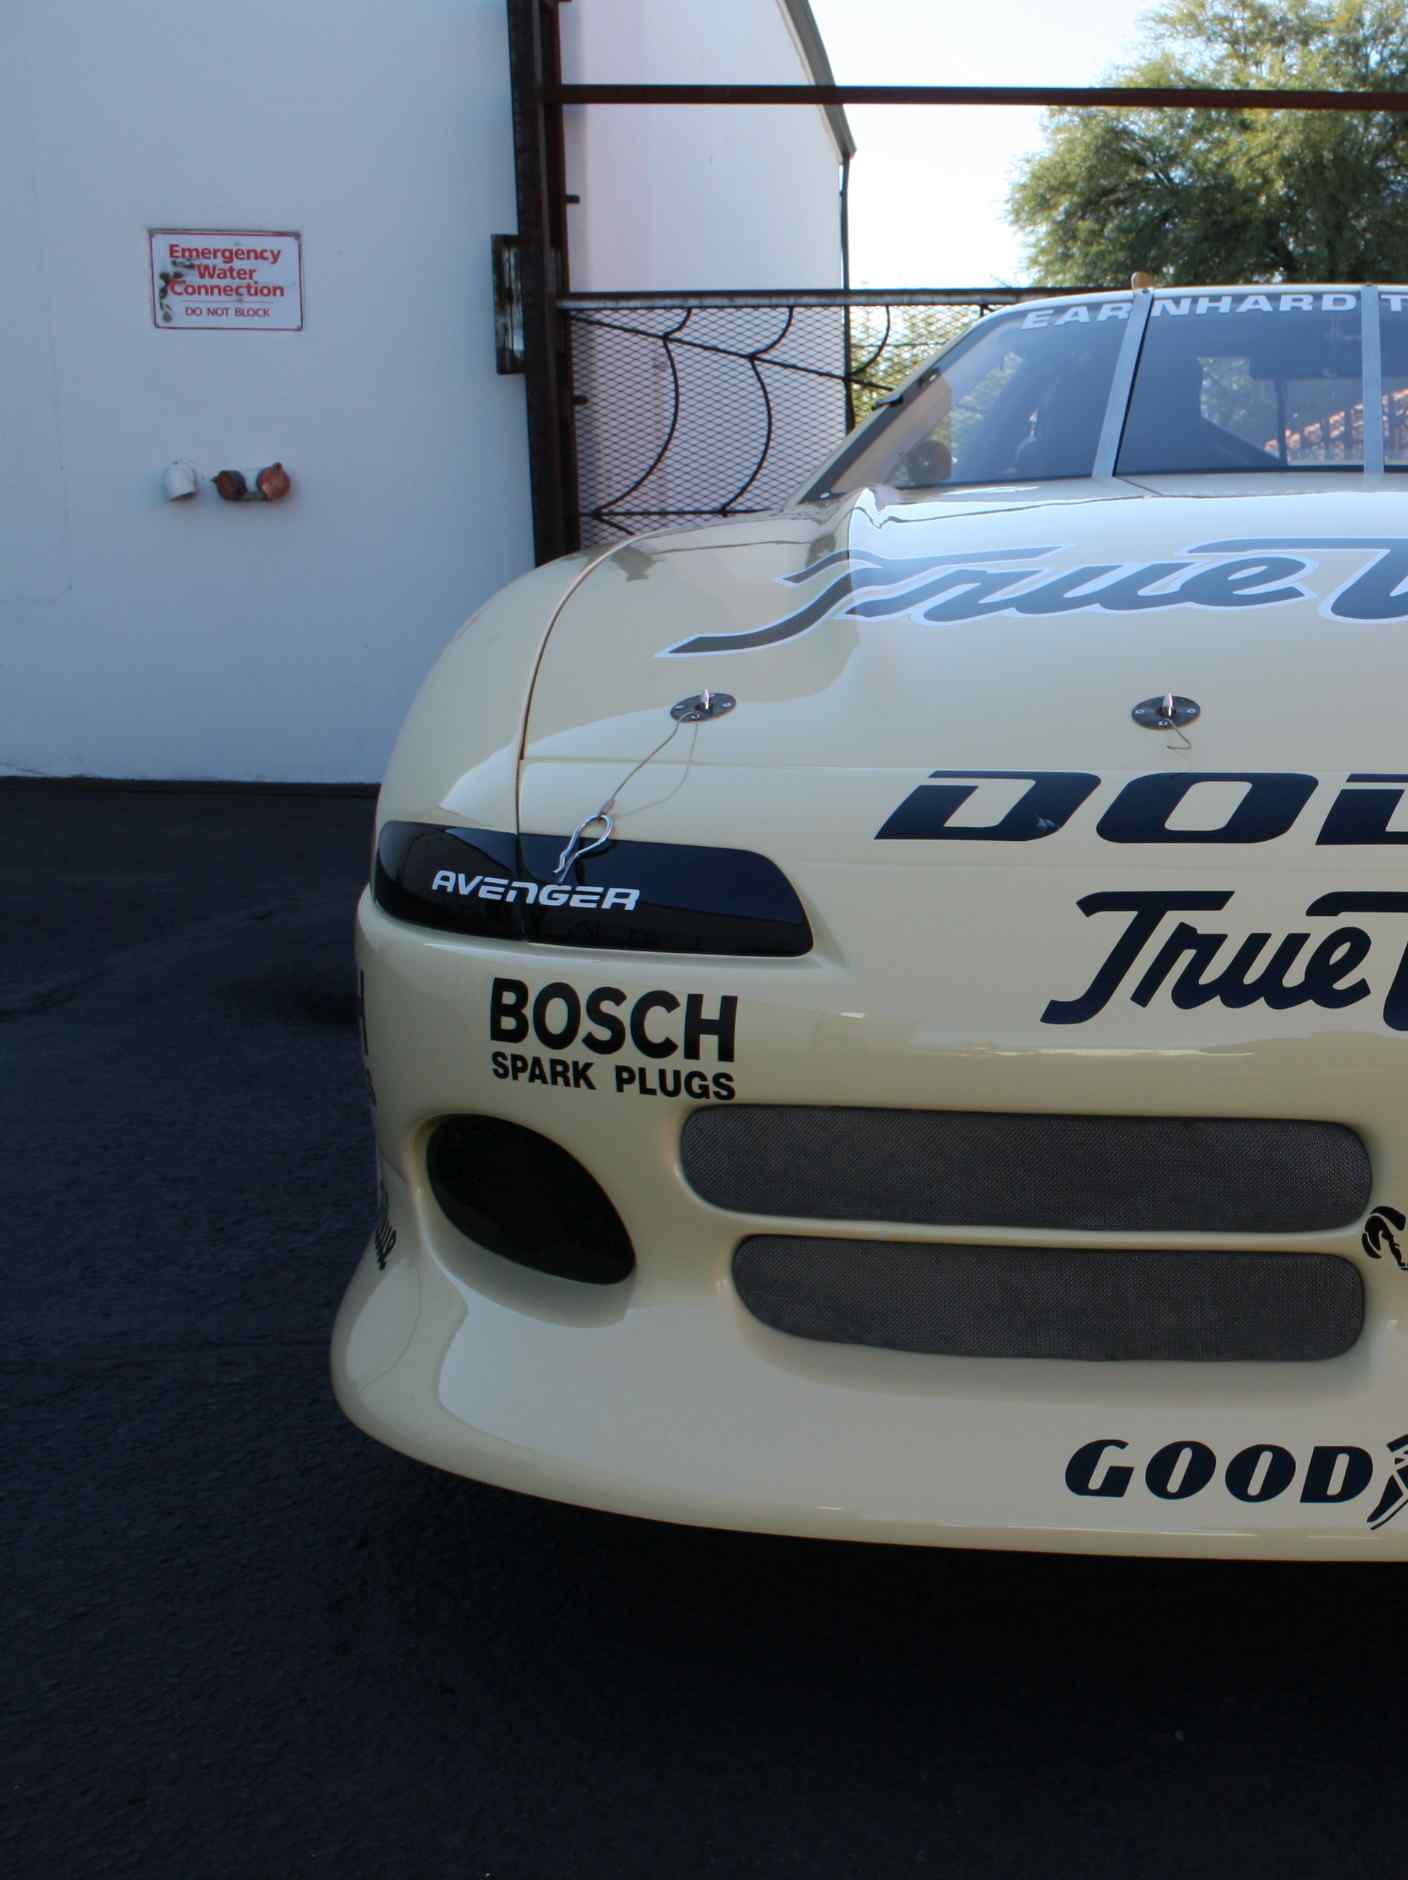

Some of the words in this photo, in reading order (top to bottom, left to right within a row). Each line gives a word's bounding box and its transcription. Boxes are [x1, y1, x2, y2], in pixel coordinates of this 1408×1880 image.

[169, 244, 281, 264] Emergency
[195, 263, 256, 280] Water
[169, 280, 284, 297] Connection
[185, 306, 203, 317] DO
[207, 307, 230, 317] NOT
[234, 307, 271, 318] BLOCK
[431, 869, 641, 911] AVENGER
[1039, 889, 1372, 1025] True
[489, 976, 739, 1063] BOSCH
[491, 1050, 597, 1091] SPARK
[615, 1064, 737, 1101] PLUGS
